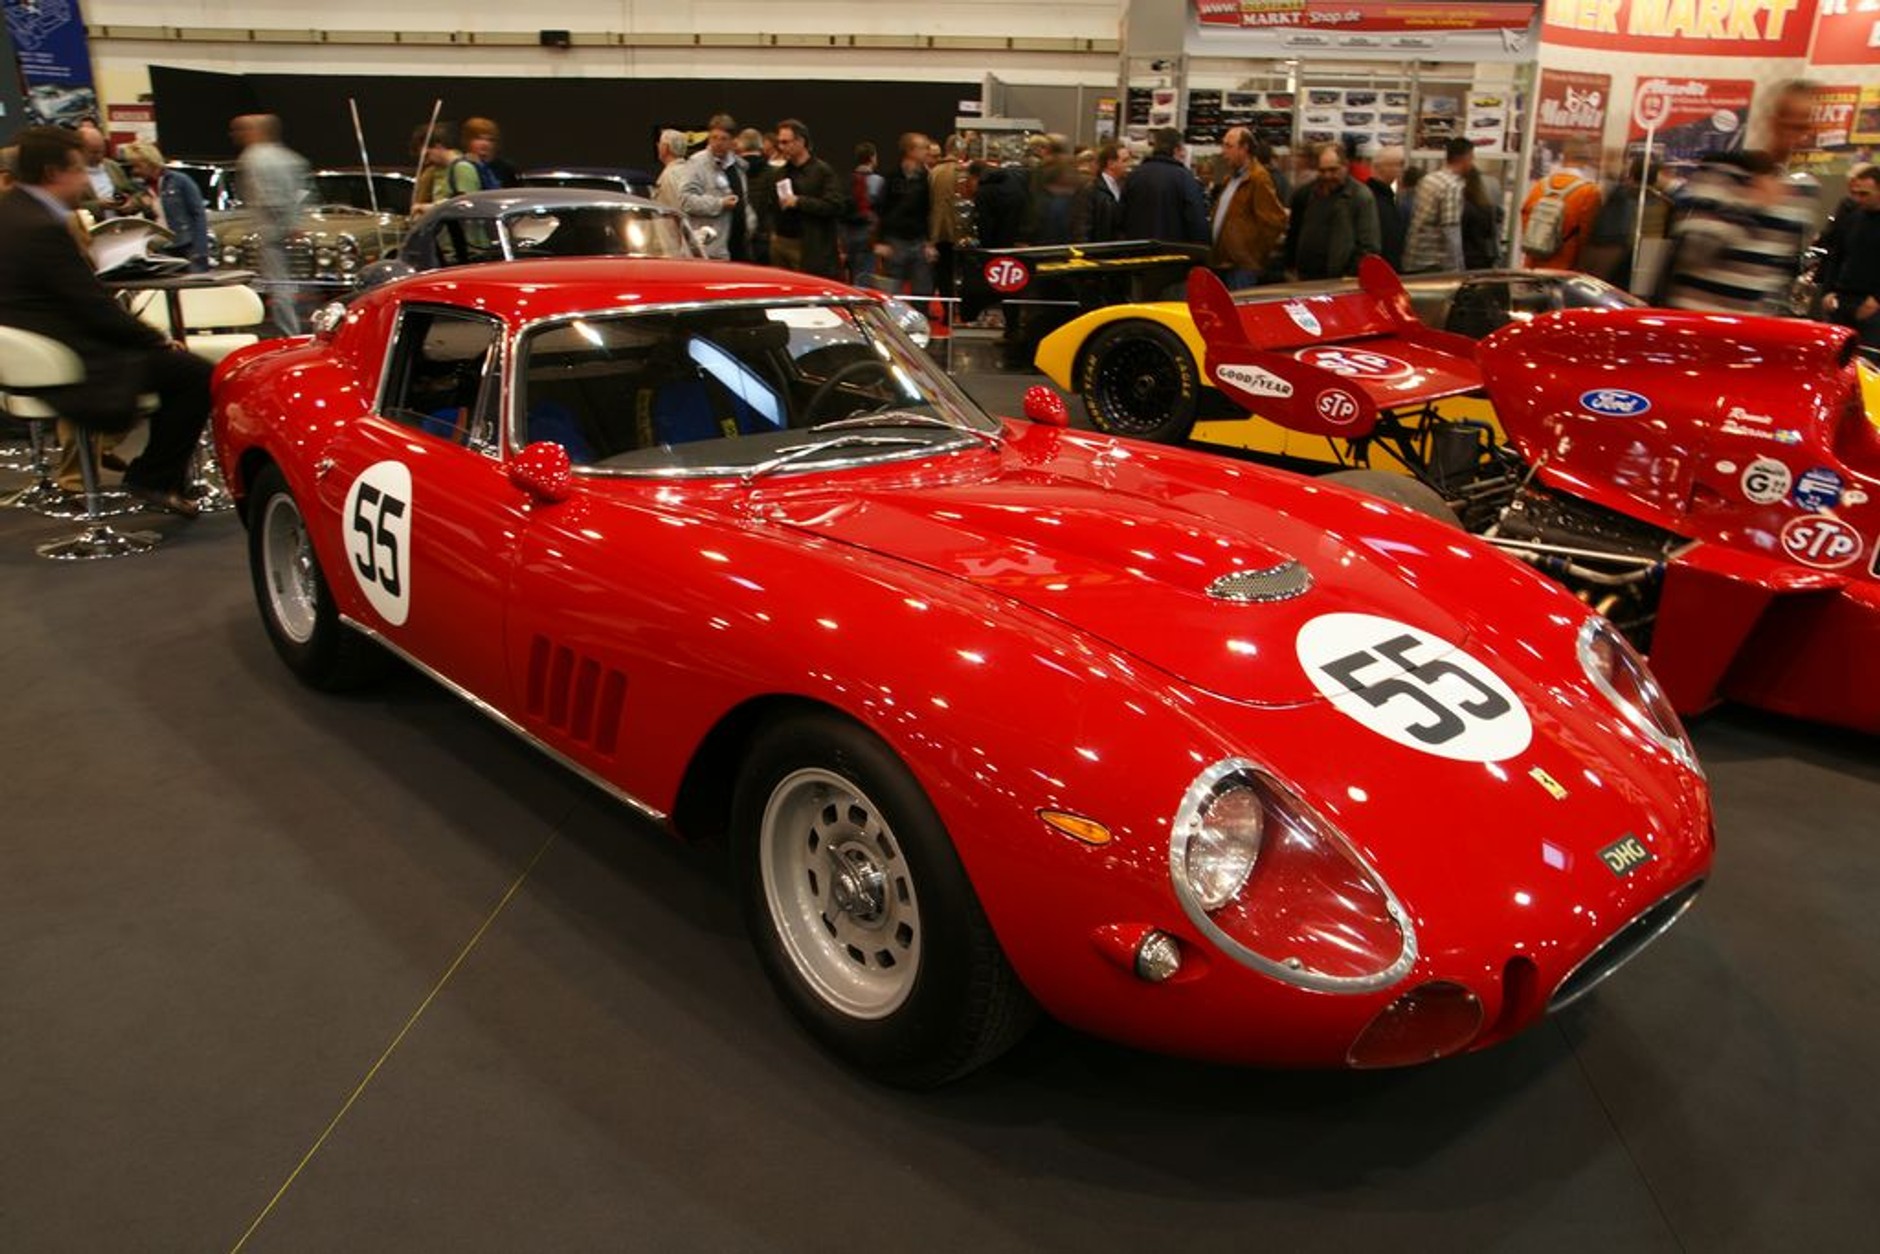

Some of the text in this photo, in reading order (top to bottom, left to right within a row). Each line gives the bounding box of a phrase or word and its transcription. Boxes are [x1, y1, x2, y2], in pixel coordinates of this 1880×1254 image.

[1242, 12, 1302, 26] MARKT
[1627, 0, 1797, 41] MARKT
[987, 260, 1025, 287] STP
[1315, 351, 1390, 375] STP
[1218, 366, 1292, 396] GOODYEAR
[1319, 392, 1355, 418] STP
[1591, 390, 1639, 412] Ford
[353, 481, 406, 598] 55
[1786, 521, 1854, 558] STP
[1319, 633, 1511, 745] 55
